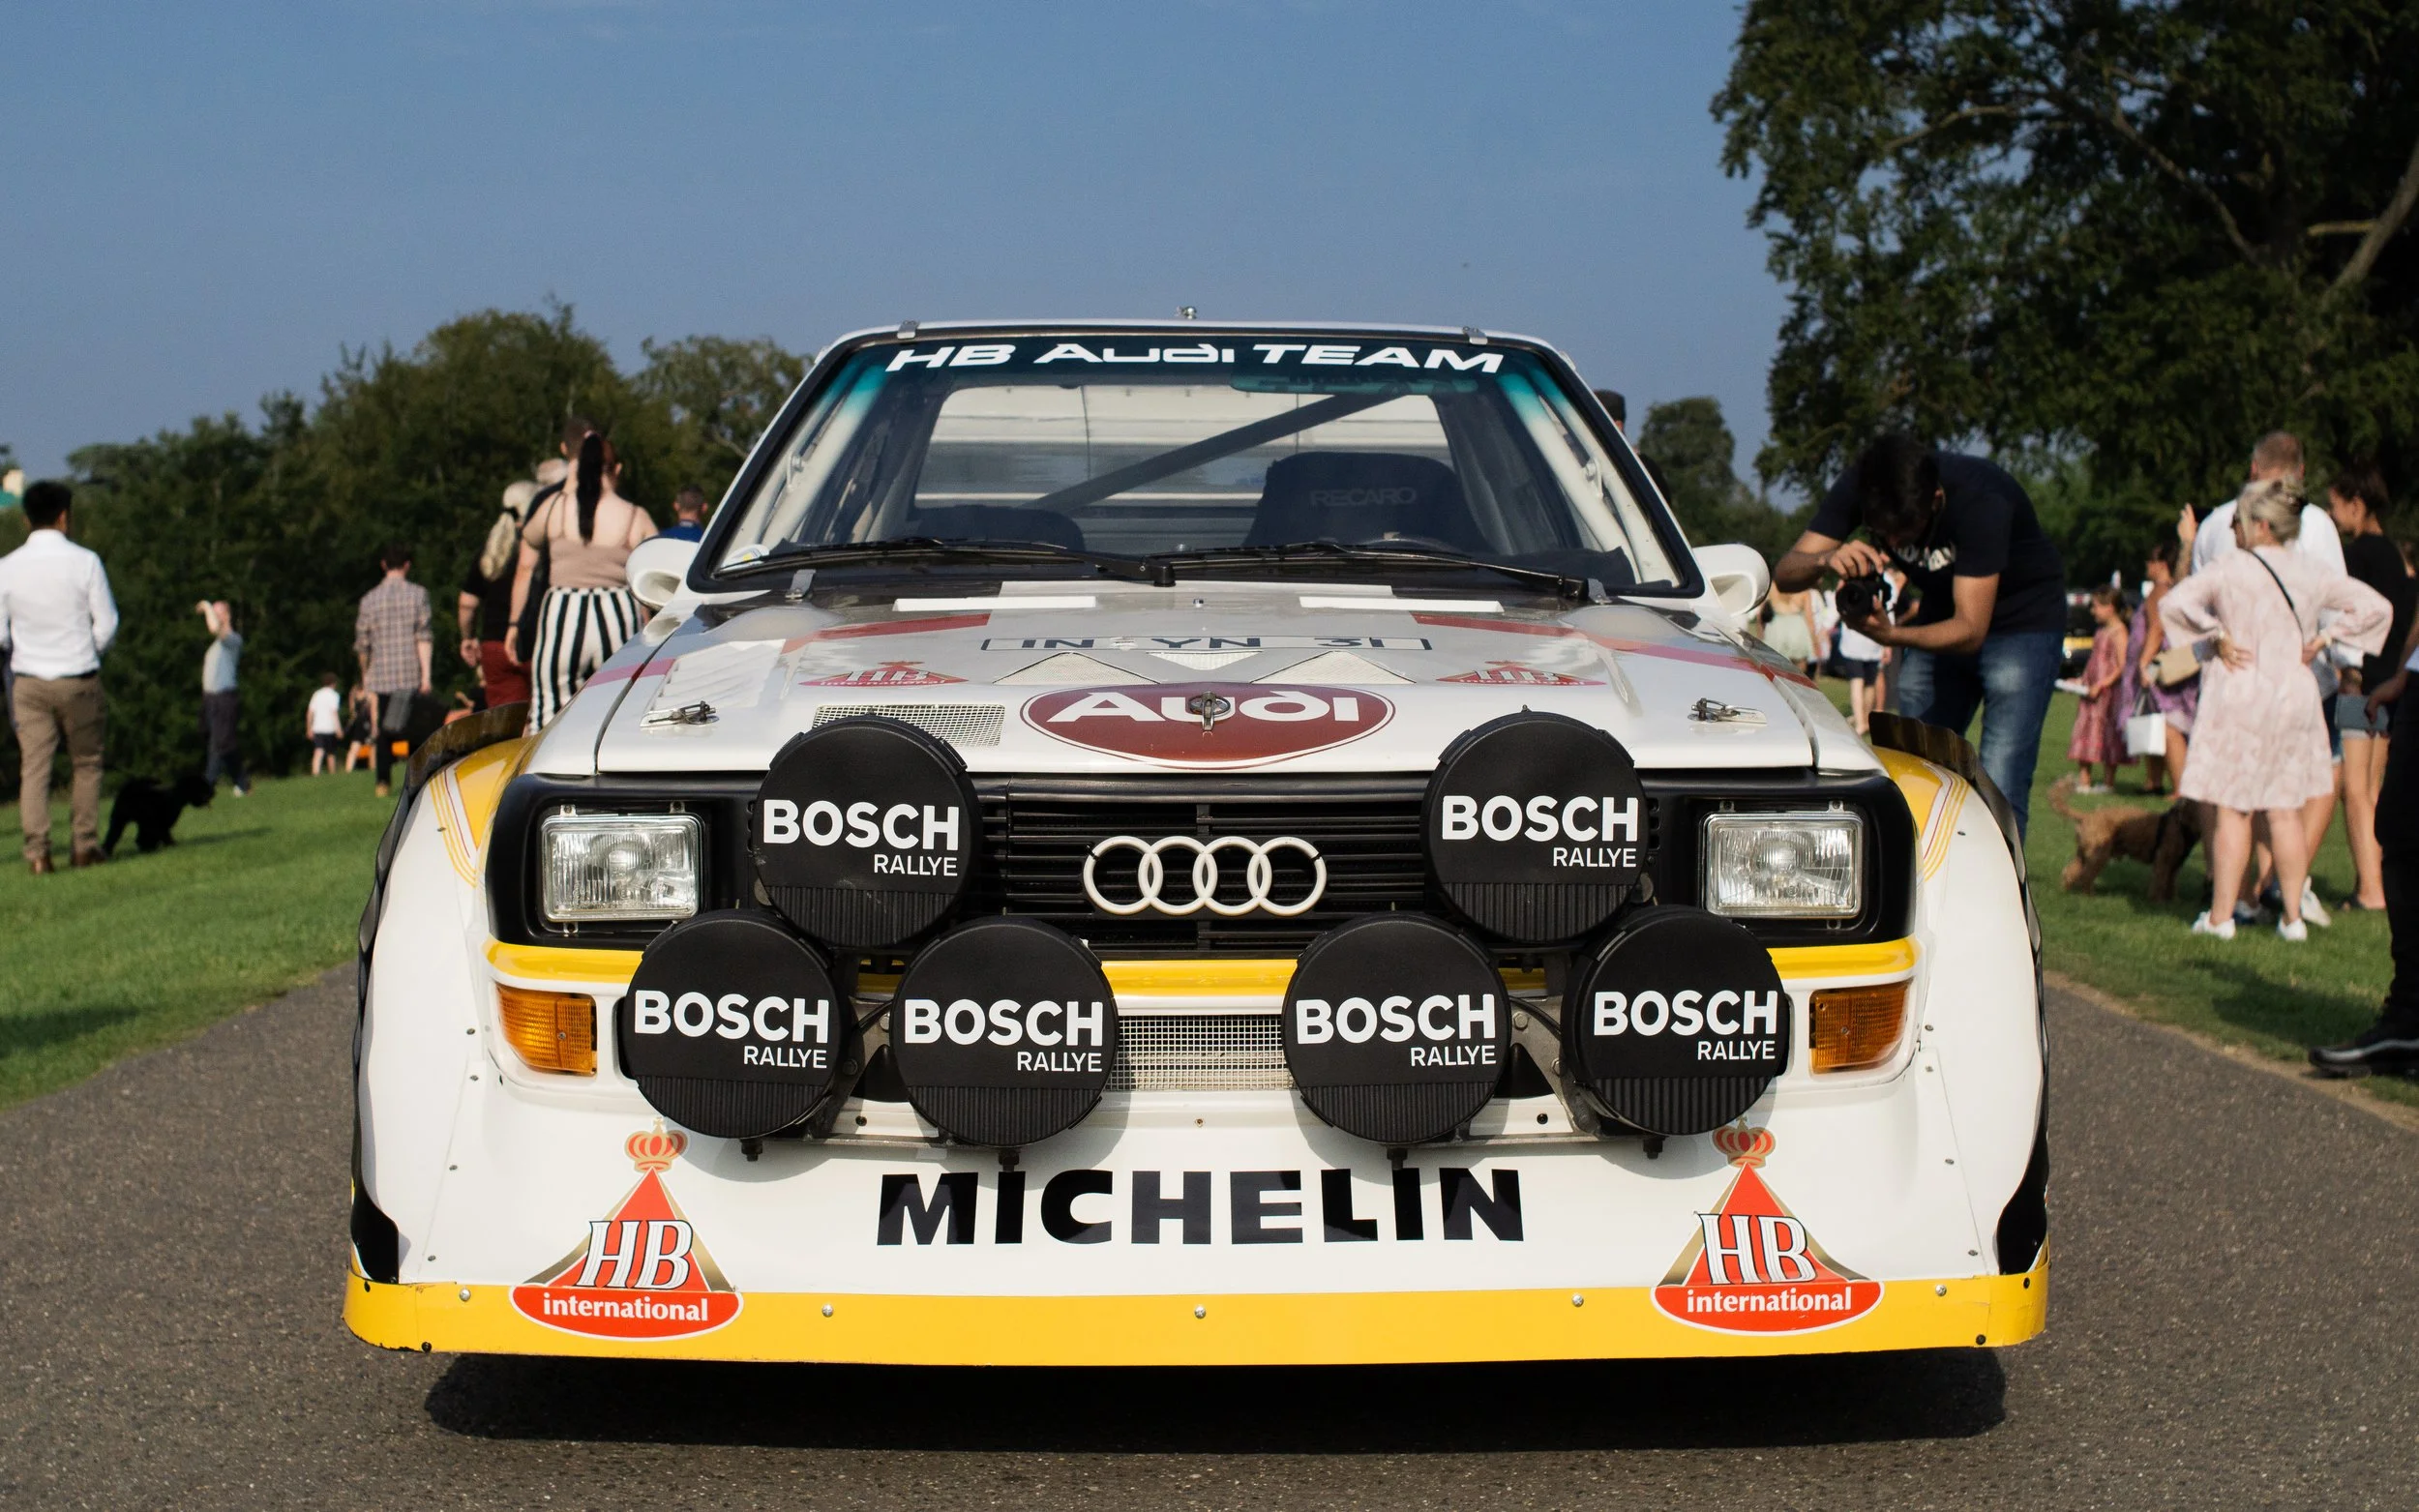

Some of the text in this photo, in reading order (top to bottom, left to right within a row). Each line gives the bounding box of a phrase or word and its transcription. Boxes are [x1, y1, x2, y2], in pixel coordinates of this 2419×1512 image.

[885, 343, 1505, 373] HB Audi TEAM
[1310, 486, 1418, 507] RECARO
[1022, 638, 1094, 649] IN
[1151, 637, 1261, 649] YN
[1046, 691, 1359, 723] Audi
[762, 799, 960, 851] BOSCH
[1442, 794, 1639, 843] BOSCH
[874, 853, 958, 877] RALLYE
[1552, 846, 1637, 868] RALLYE
[634, 990, 829, 1044] BOSCH
[904, 998, 1104, 1047] BOSCH
[1296, 993, 1496, 1044] BOSCH
[1594, 990, 1778, 1037] BOSCH
[743, 1045, 827, 1070] RALLYE
[1016, 1051, 1103, 1073] RALLYE
[1410, 1045, 1497, 1067] RALLYE
[1697, 1040, 1776, 1060] RALLYE
[877, 1168, 1524, 1246] MICHELIN
[573, 1219, 694, 1290] HB
[1695, 1213, 1819, 1286] HB
[543, 1291, 709, 1321] international
[1687, 1286, 1852, 1314] international
